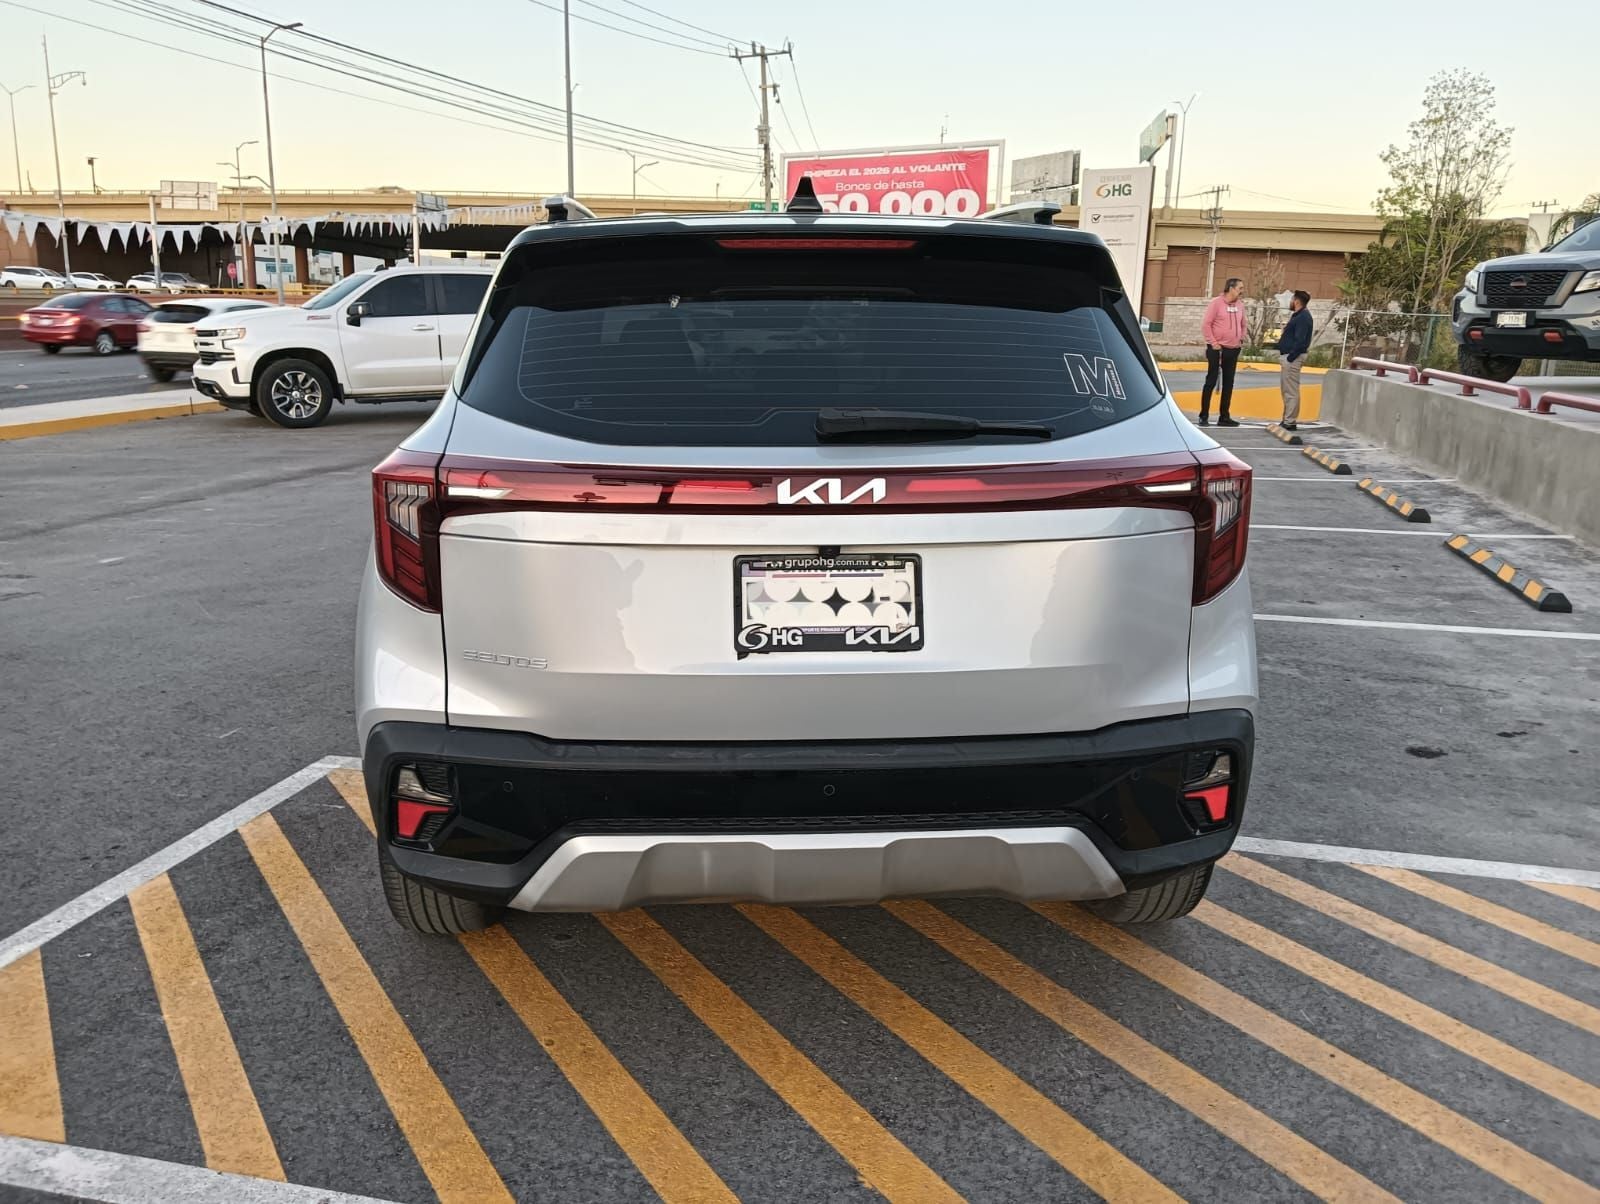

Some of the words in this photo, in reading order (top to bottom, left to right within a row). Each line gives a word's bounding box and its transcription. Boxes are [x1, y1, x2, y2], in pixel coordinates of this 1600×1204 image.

[849, 167, 862, 177] EL
[863, 166, 890, 176] 2026
[891, 165, 907, 175] AL
[909, 162, 967, 173] VOLANTE
[835, 181, 871, 192] Bonos
[873, 179, 889, 190] de
[890, 178, 924, 189] hasta
[1112, 183, 1132, 197] HG
[777, 478, 886, 505] KIA
[784, 557, 869, 569] grupohg.com.mx
[771, 627, 804, 646] HG
[845, 626, 920, 645] KIA
[463, 649, 548, 669] SELTOS
